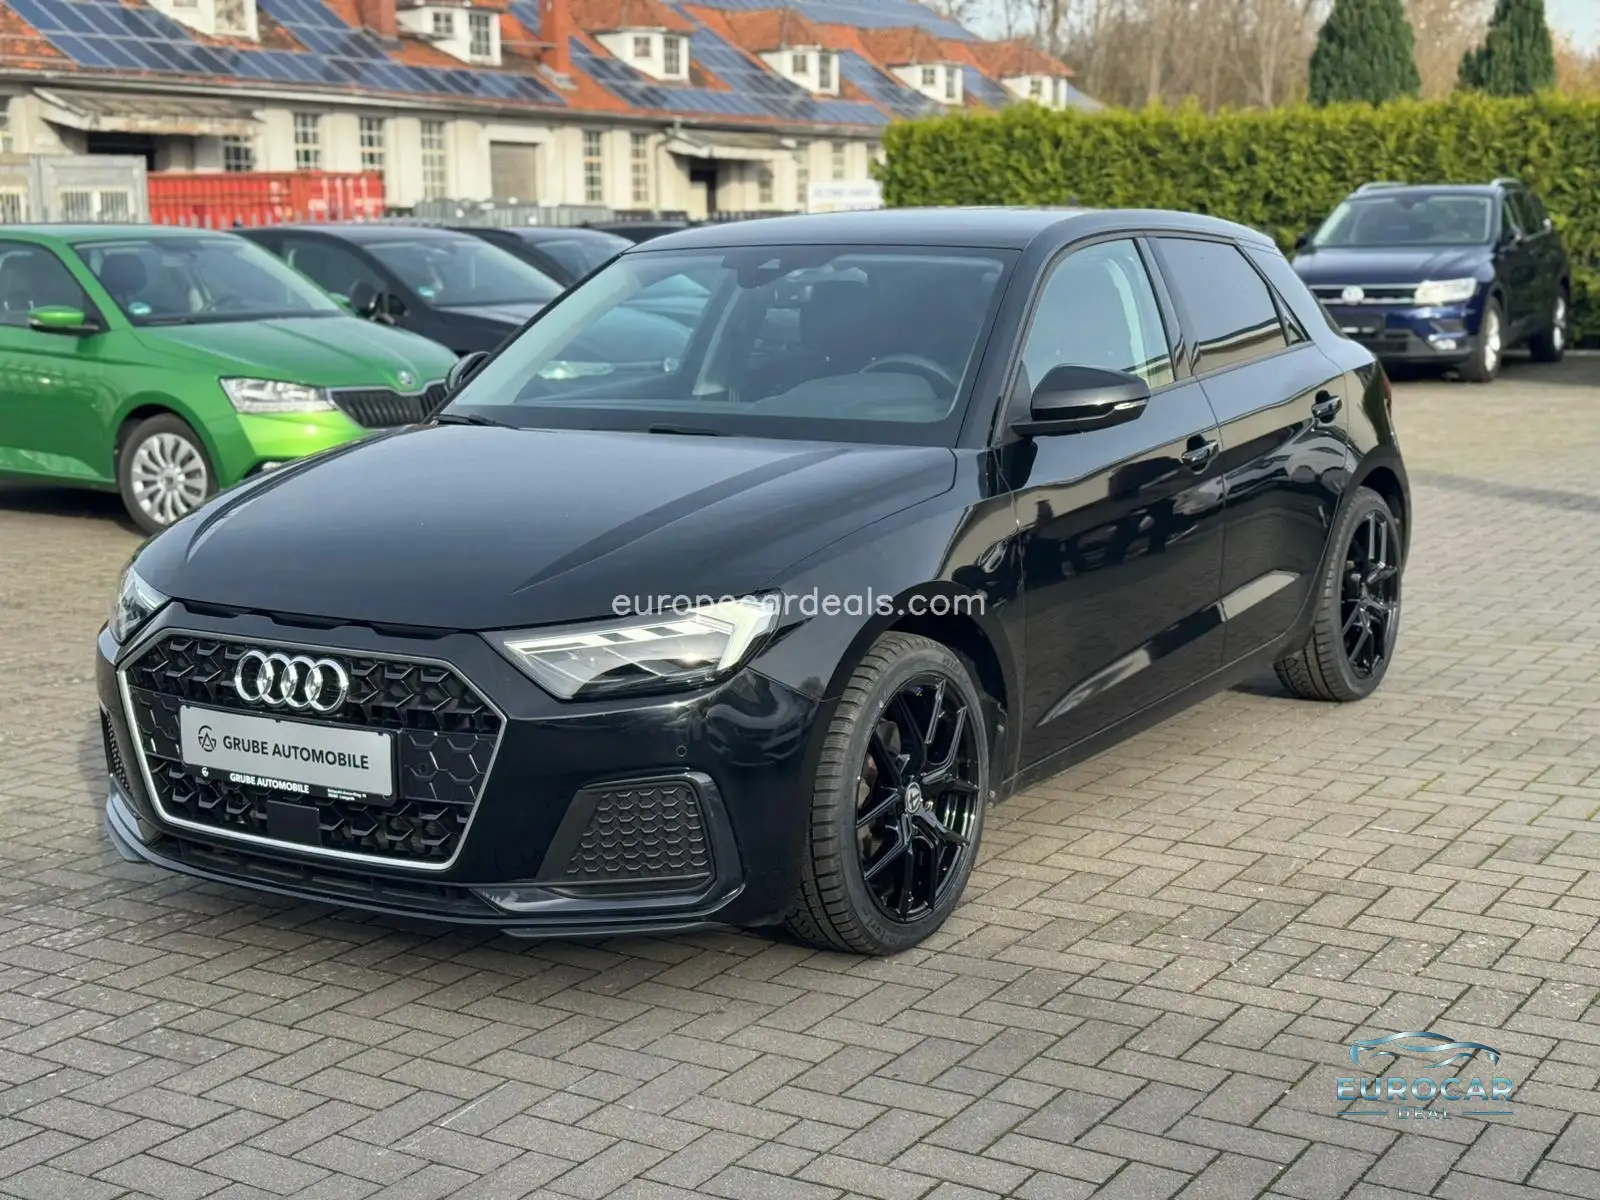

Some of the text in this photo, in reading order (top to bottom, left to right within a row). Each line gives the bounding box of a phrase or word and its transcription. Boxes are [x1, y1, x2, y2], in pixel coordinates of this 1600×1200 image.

[223, 735, 369, 770] GRUBE AUTOMOBILE
[230, 772, 256, 786] GRUBE
[257, 778, 310, 794] AUTOMOBILE
